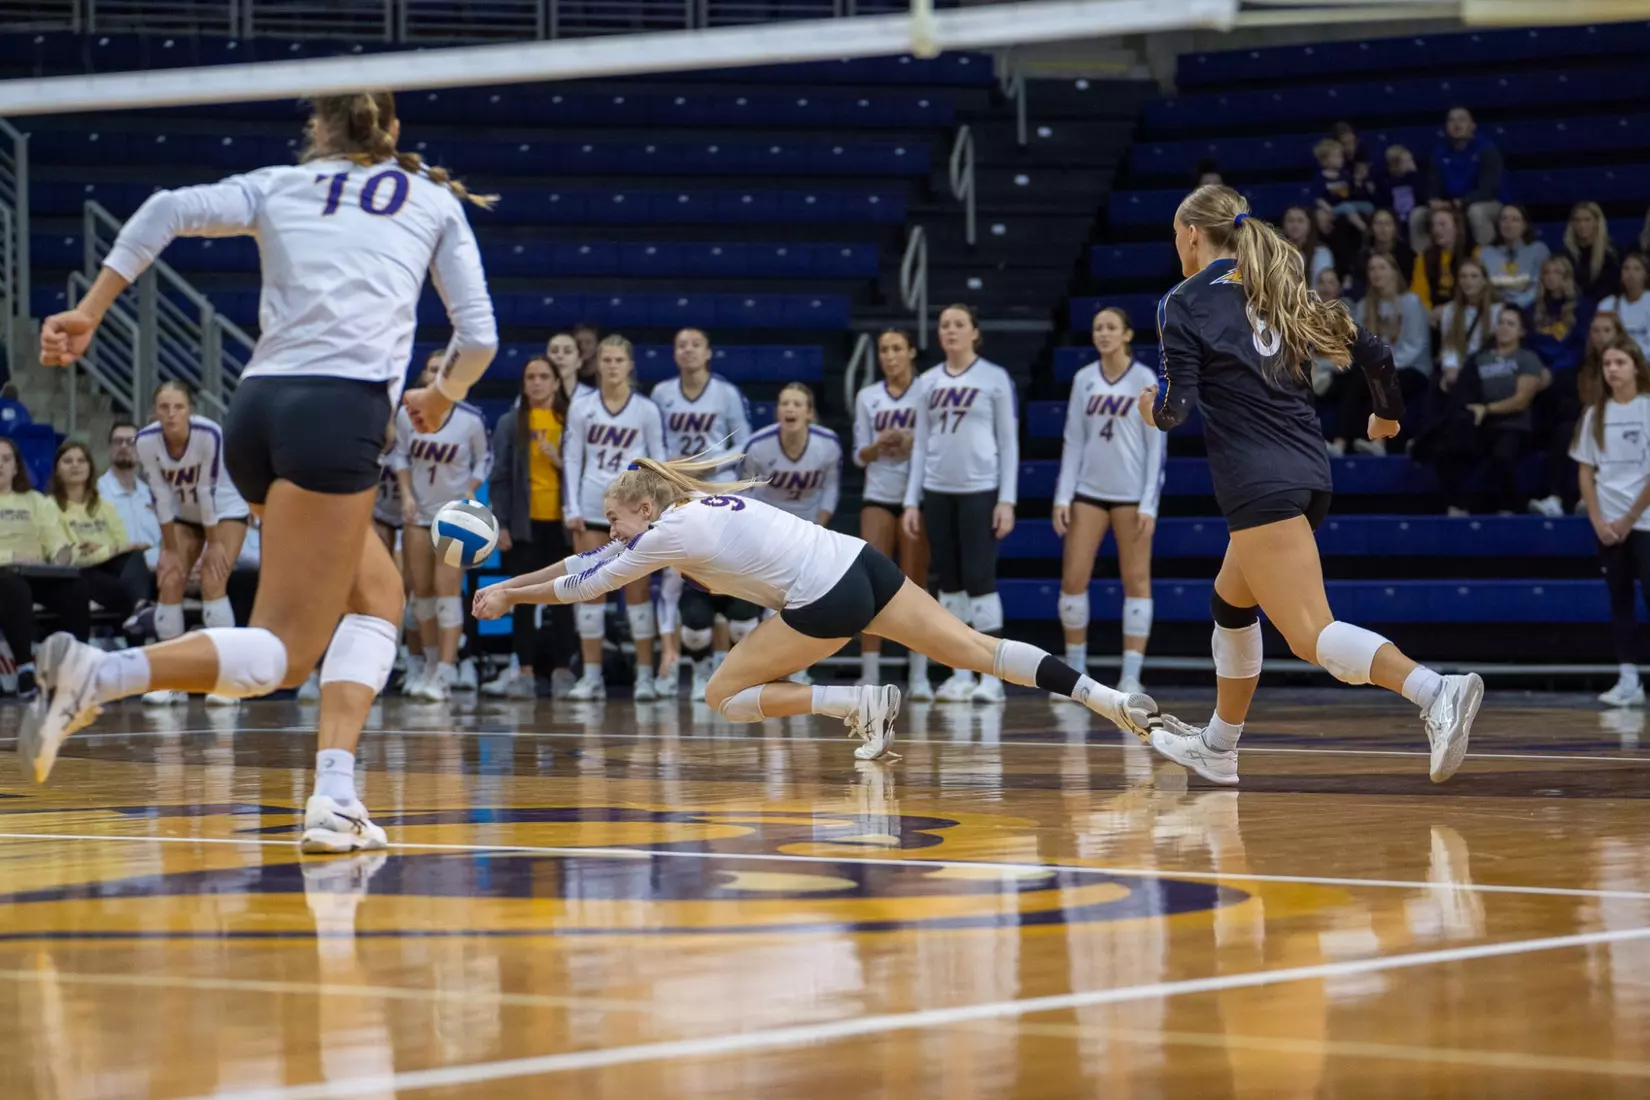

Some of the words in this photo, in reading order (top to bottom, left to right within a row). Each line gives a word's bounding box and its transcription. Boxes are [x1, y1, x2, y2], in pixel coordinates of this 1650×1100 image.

[930, 386, 981, 411] UNI
[1086, 394, 1136, 418] UNI
[668, 412, 717, 433] UNI
[874, 407, 917, 432] UNI
[939, 410, 967, 435] 17
[1099, 418, 1115, 442] 4
[587, 424, 639, 449] UNI
[680, 435, 706, 456] 22
[411, 438, 460, 465] UNI
[596, 449, 623, 473] 14
[427, 464, 437, 487] 1
[767, 469, 825, 489] UNI
[175, 487, 198, 504] 11
[700, 494, 746, 512] 9
